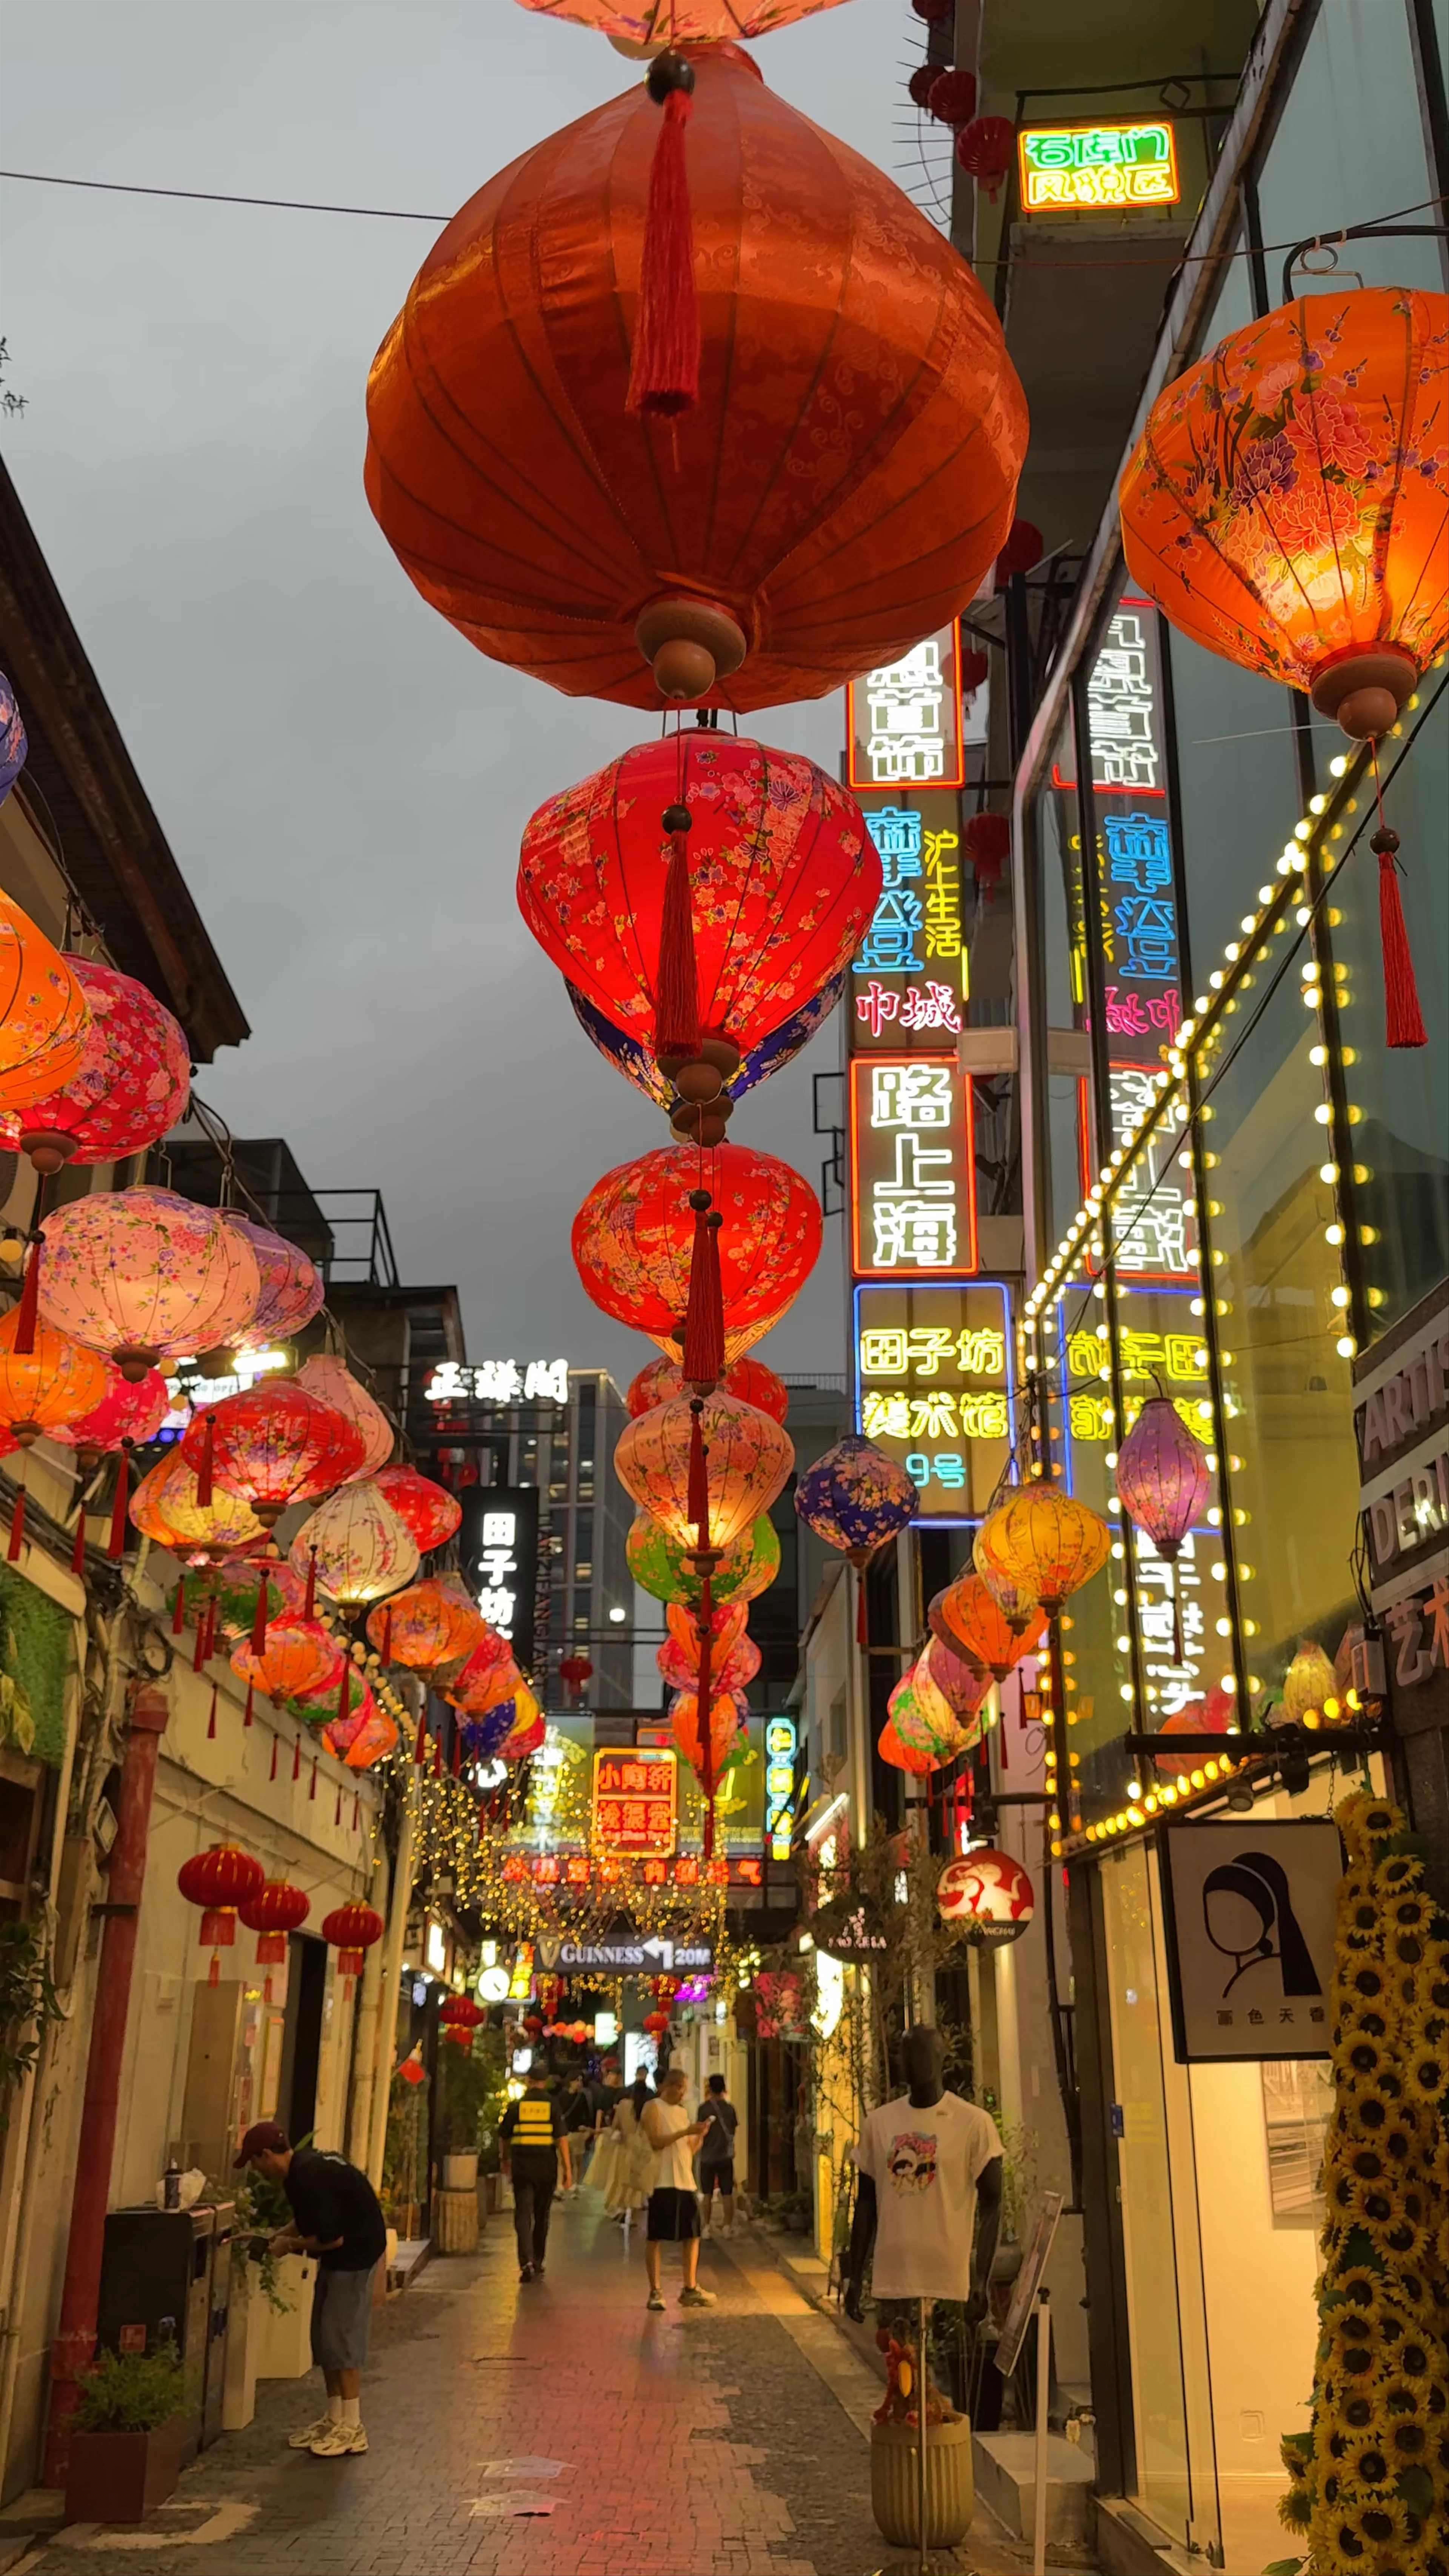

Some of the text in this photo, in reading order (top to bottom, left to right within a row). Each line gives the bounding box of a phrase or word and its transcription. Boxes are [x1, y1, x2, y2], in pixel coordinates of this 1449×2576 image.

[1025, 127, 1169, 168] 石库门
[1029, 163, 1174, 204] 风貌区
[852, 806, 924, 973] 摩登
[924, 829, 961, 958] 沪上生活
[871, 1065, 956, 1267] 路上海
[860, 1327, 1004, 1375] 田子坊
[863, 1392, 1008, 1438] 美术馆
[906, 1453, 966, 1489] 9号
[478, 1513, 517, 1640] 田子坊
[561, 1944, 645, 1965] GUINNESS
